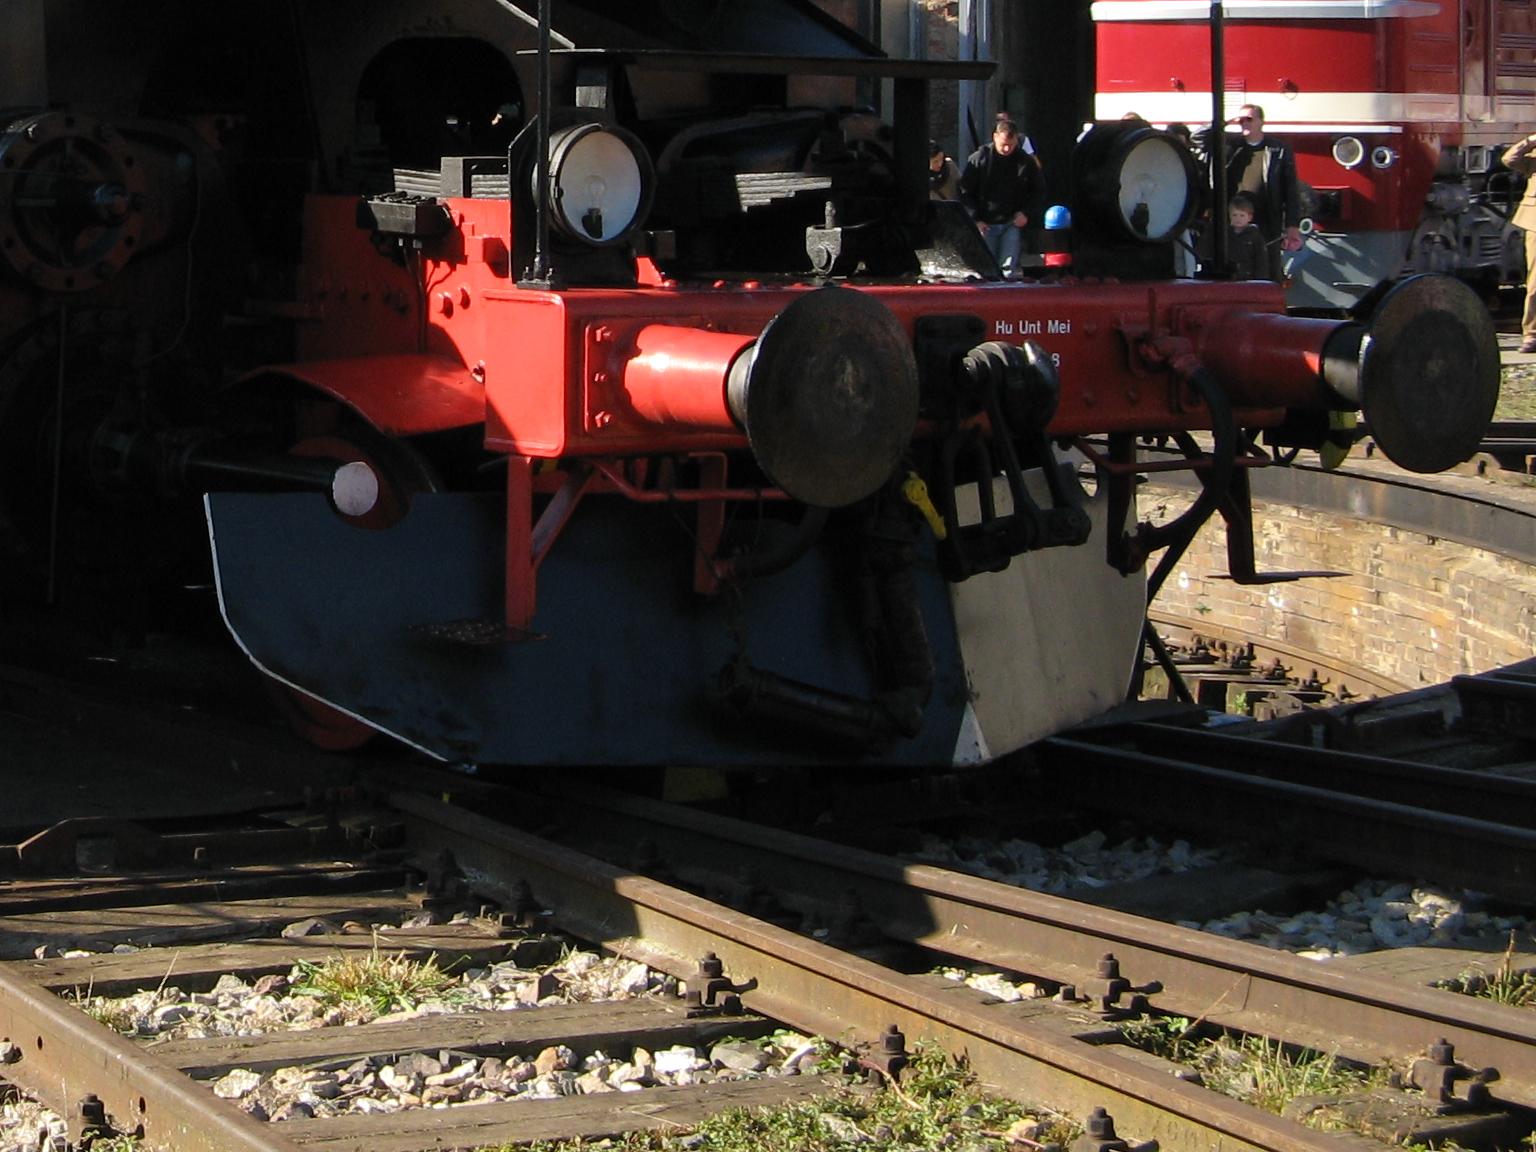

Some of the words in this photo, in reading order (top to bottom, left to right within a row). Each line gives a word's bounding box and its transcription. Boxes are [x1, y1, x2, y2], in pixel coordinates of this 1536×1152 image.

[995, 320, 1013, 335] Hu
[1019, 319, 1041, 335] Unt
[1047, 319, 1071, 334] Mei
